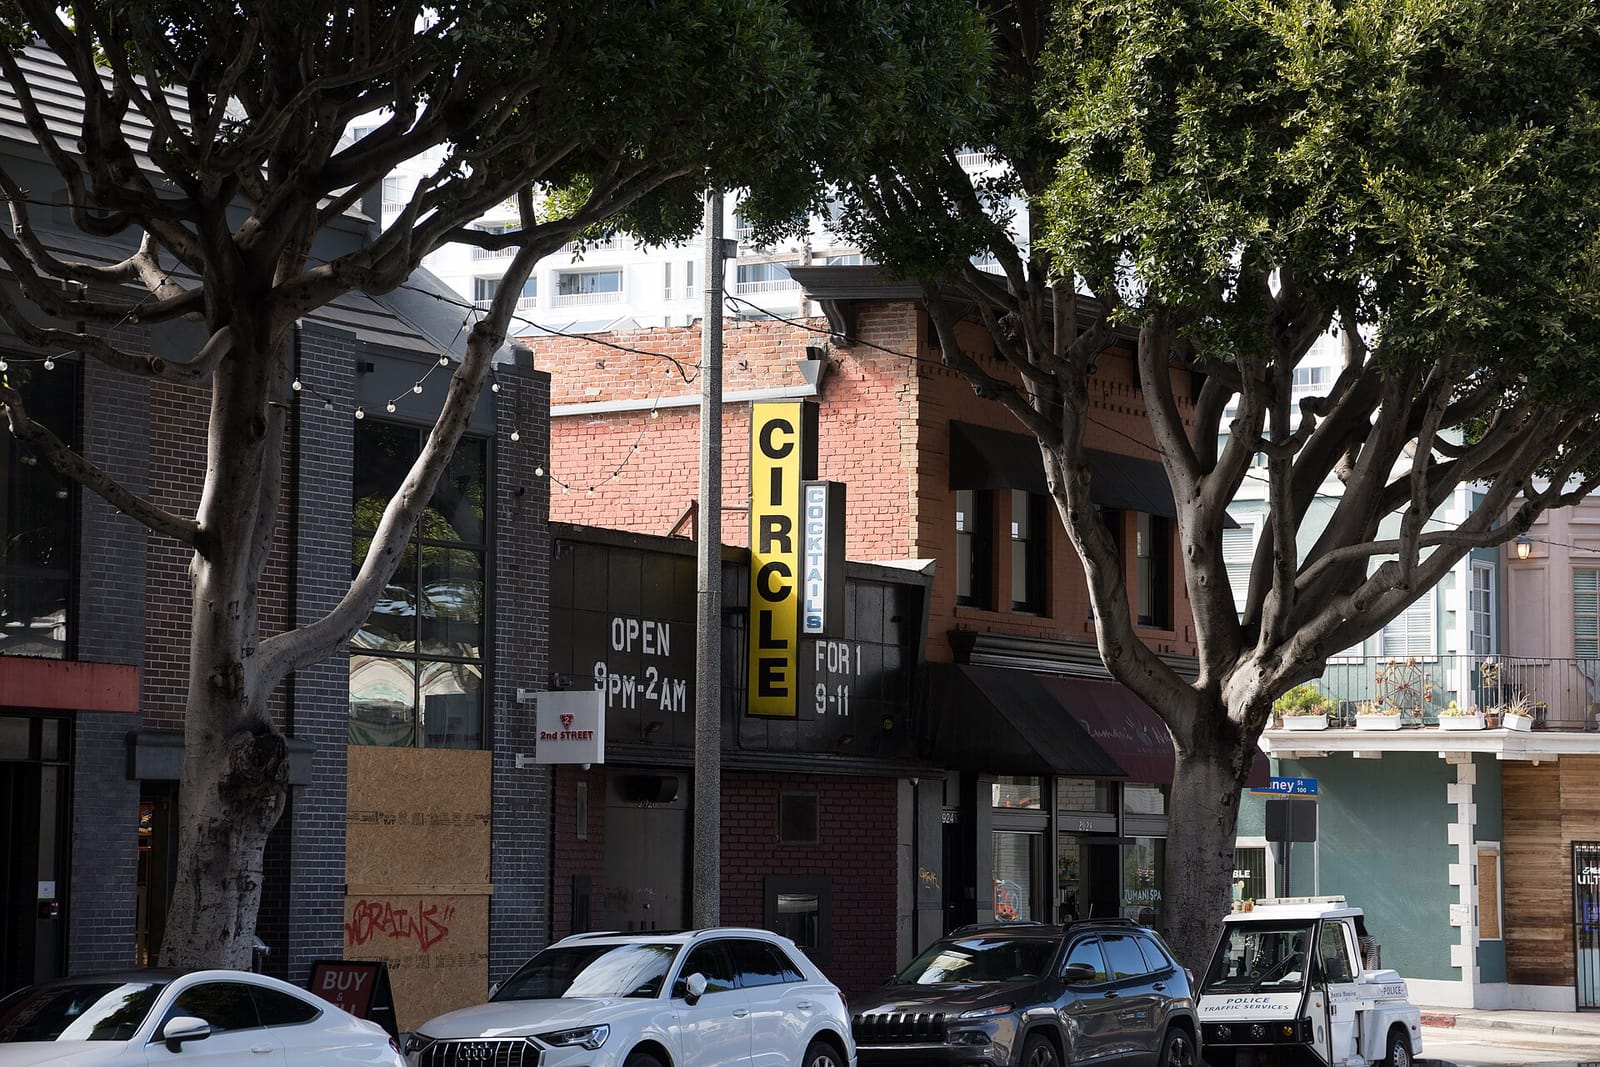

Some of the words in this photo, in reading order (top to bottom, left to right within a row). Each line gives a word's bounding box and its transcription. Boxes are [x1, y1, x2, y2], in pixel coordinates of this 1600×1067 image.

[757, 418, 794, 698] CIRCLE
[806, 489, 823, 629] COCKTAILS
[611, 616, 669, 656] OPEN
[815, 640, 850, 675] FOR
[593, 661, 686, 712] 9PM-2AM
[815, 683, 848, 716] 9-11
[540, 731, 558, 741] 2nd
[560, 730, 594, 741] STREET
[1232, 869, 1251, 878] BLE
[1150, 888, 1162, 901] SPA
[322, 970, 368, 991] BUY
[1383, 985, 1402, 995] POLICE
[336, 992, 344, 1002] &
[1204, 1004, 1240, 1012] TRAFFIC
